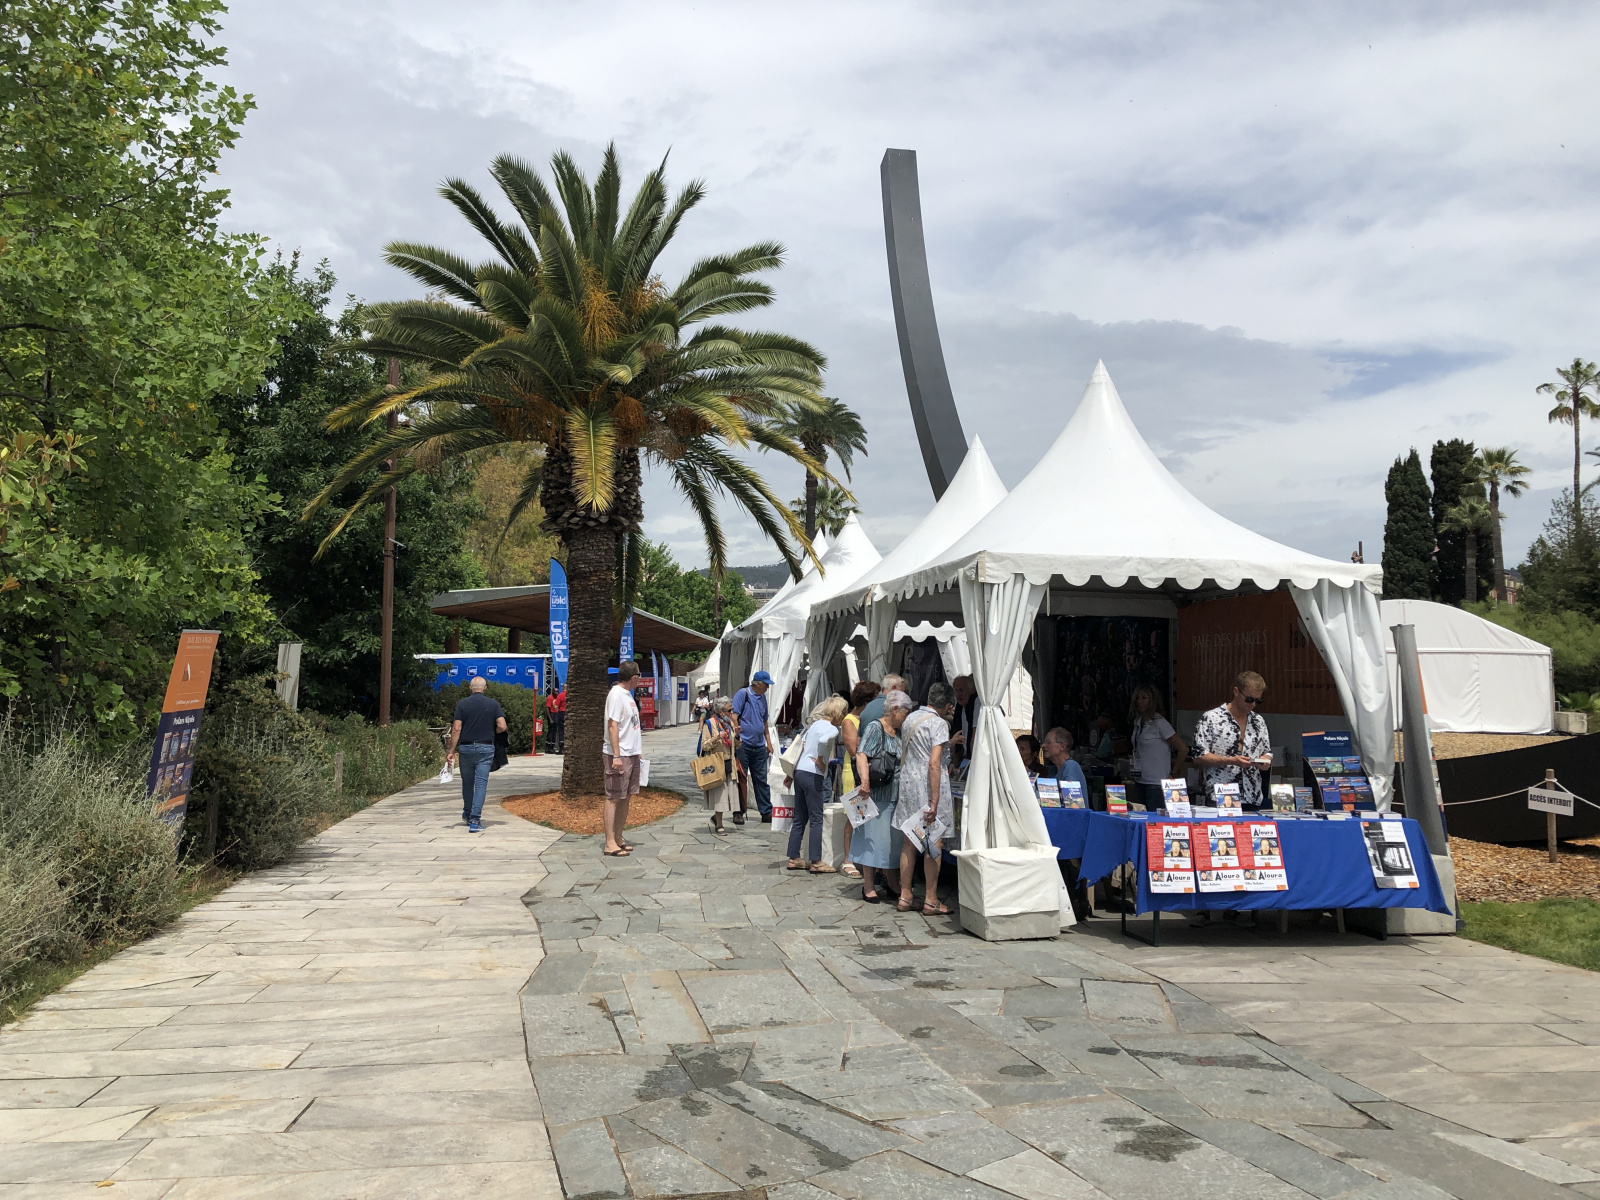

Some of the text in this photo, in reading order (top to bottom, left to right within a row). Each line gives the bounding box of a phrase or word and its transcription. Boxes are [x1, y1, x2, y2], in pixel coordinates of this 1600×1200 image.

[1214, 632, 1231, 647] DES
[1233, 629, 1267, 647] ANGES
[1529, 794, 1572, 807] ACCÈS INTERDIT
[775, 808, 784, 817] Le
[1165, 829, 1186, 838] Aloura
[1210, 828, 1231, 837] Aloura
[1253, 828, 1274, 837] Aloura
[1166, 872, 1191, 882] Aloura
[1215, 871, 1240, 881] Aloura
[1258, 870, 1283, 880] Aloura
